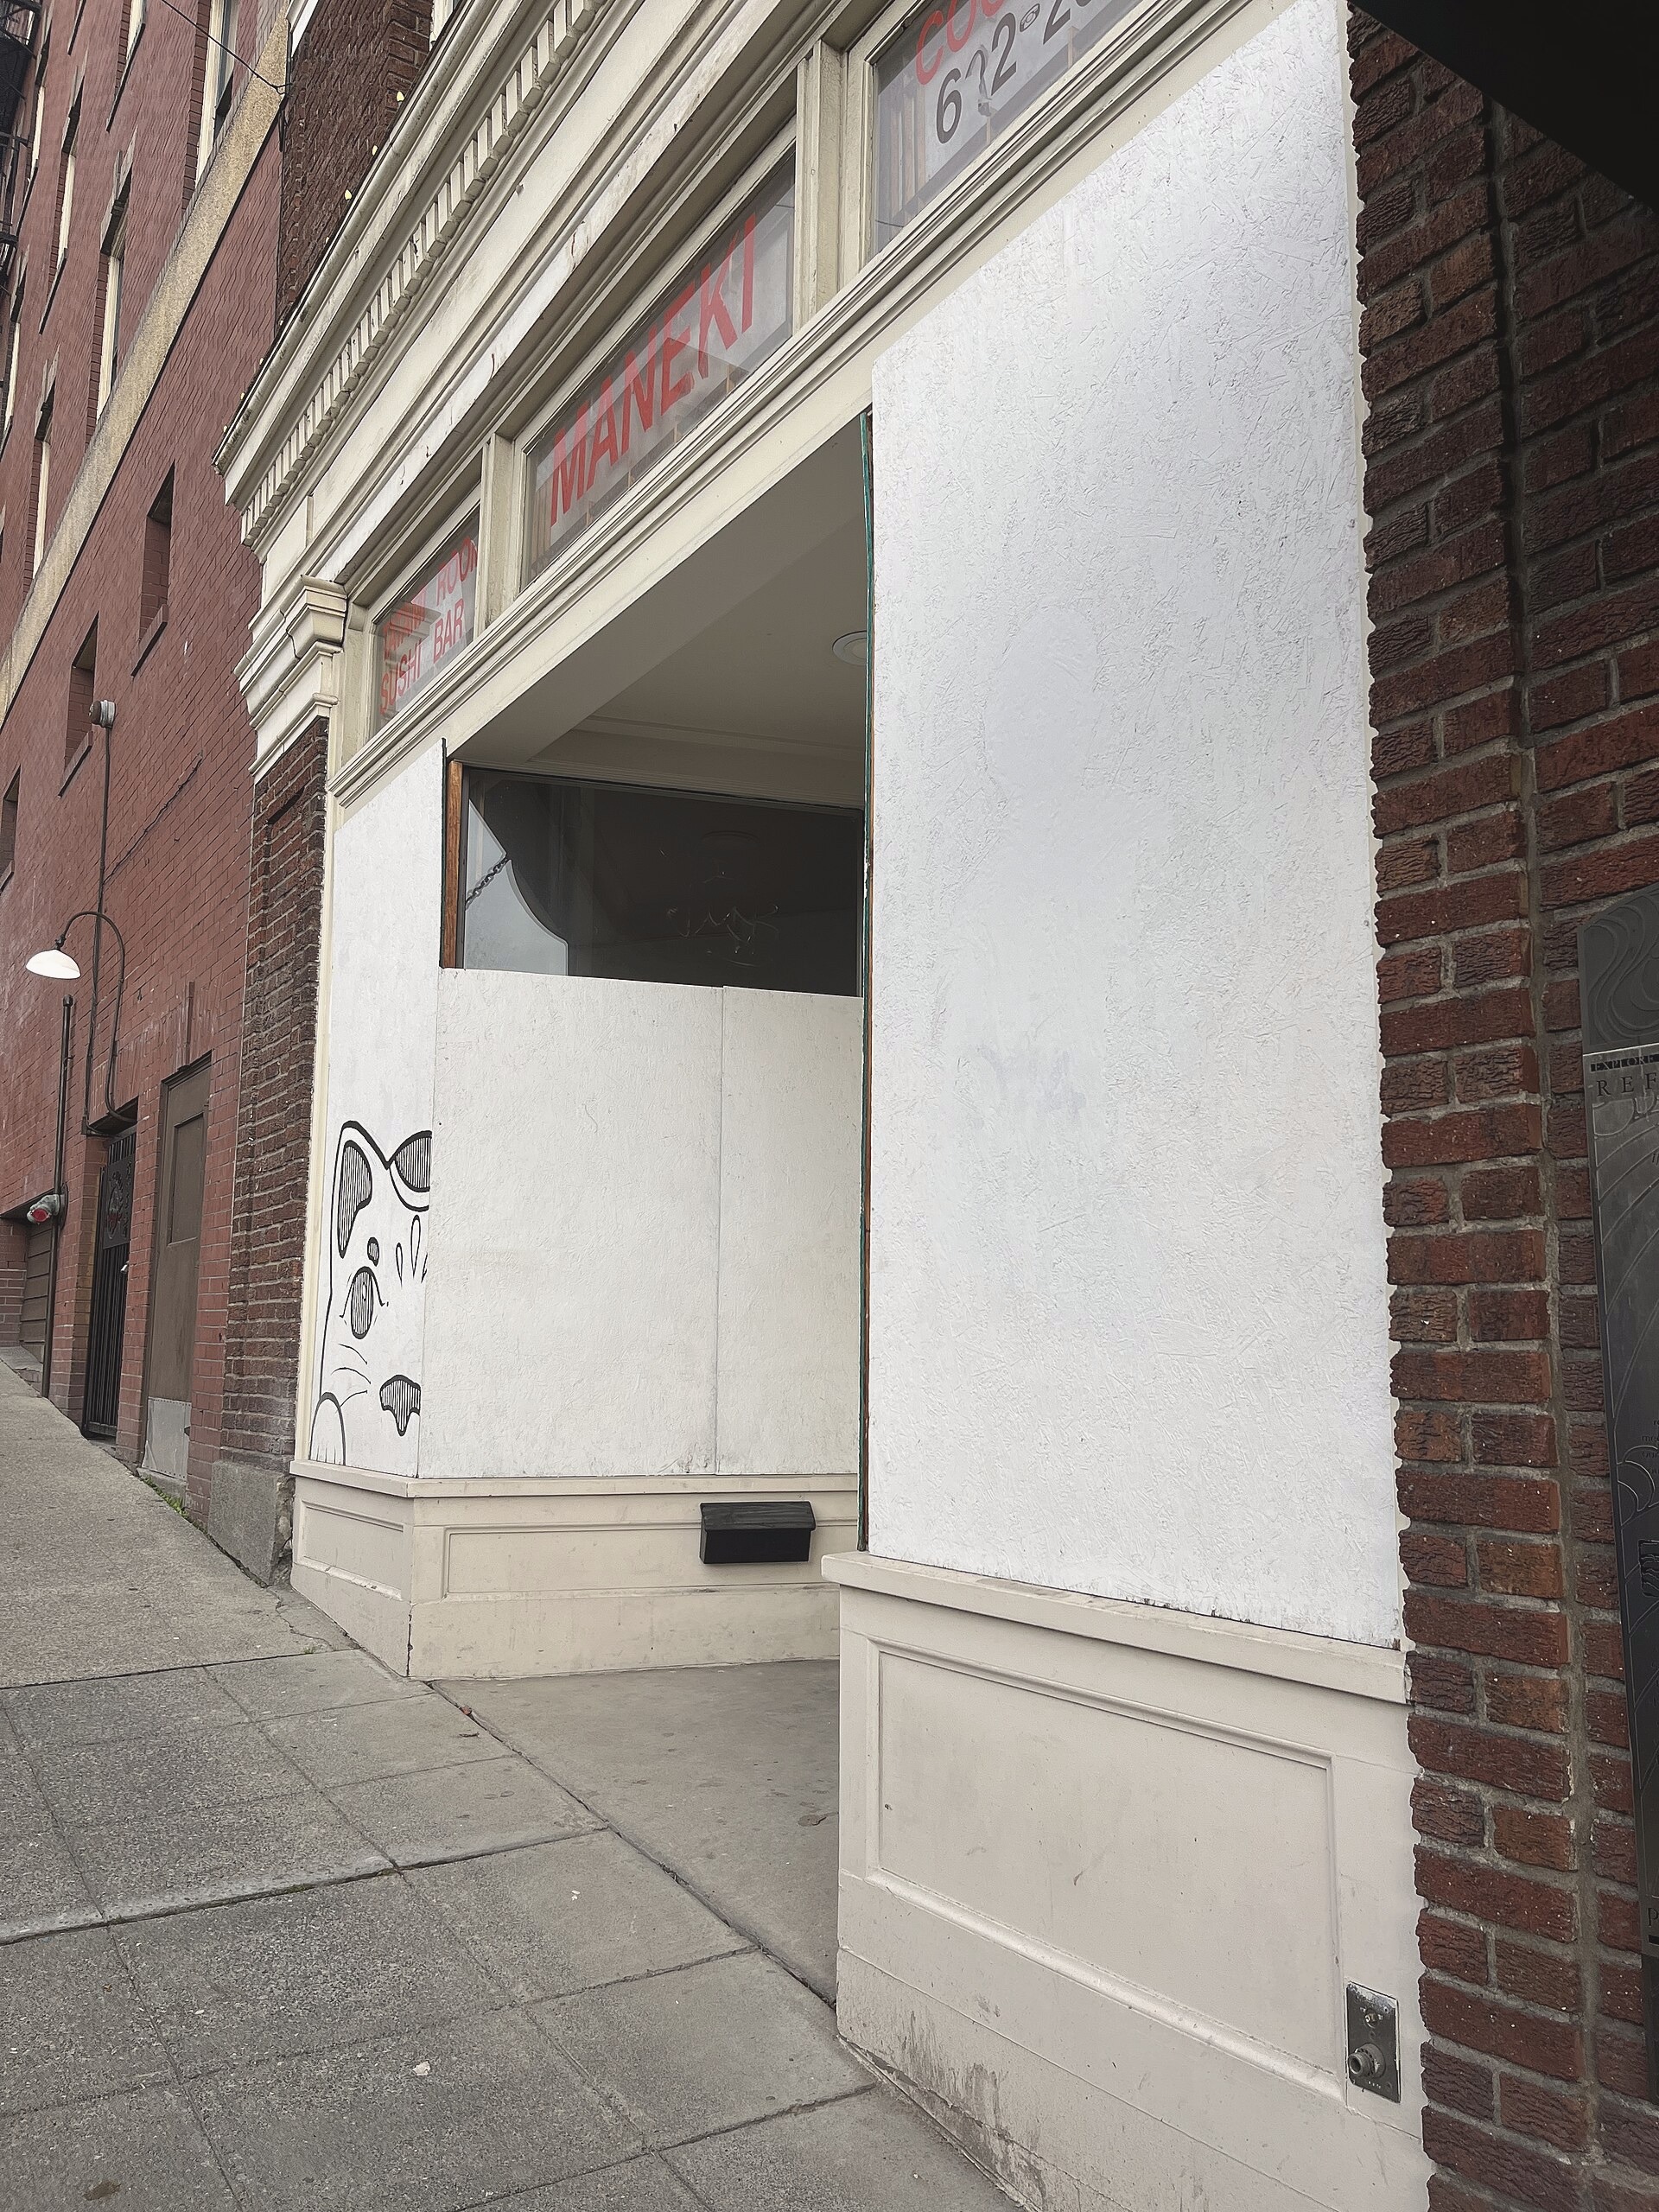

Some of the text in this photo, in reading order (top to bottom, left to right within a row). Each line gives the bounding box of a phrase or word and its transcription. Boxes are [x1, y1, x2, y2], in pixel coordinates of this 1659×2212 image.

[916, 0, 1004, 85] CO
[550, 213, 757, 527] MANEKI
[380, 597, 465, 715] SUSHI BAR
